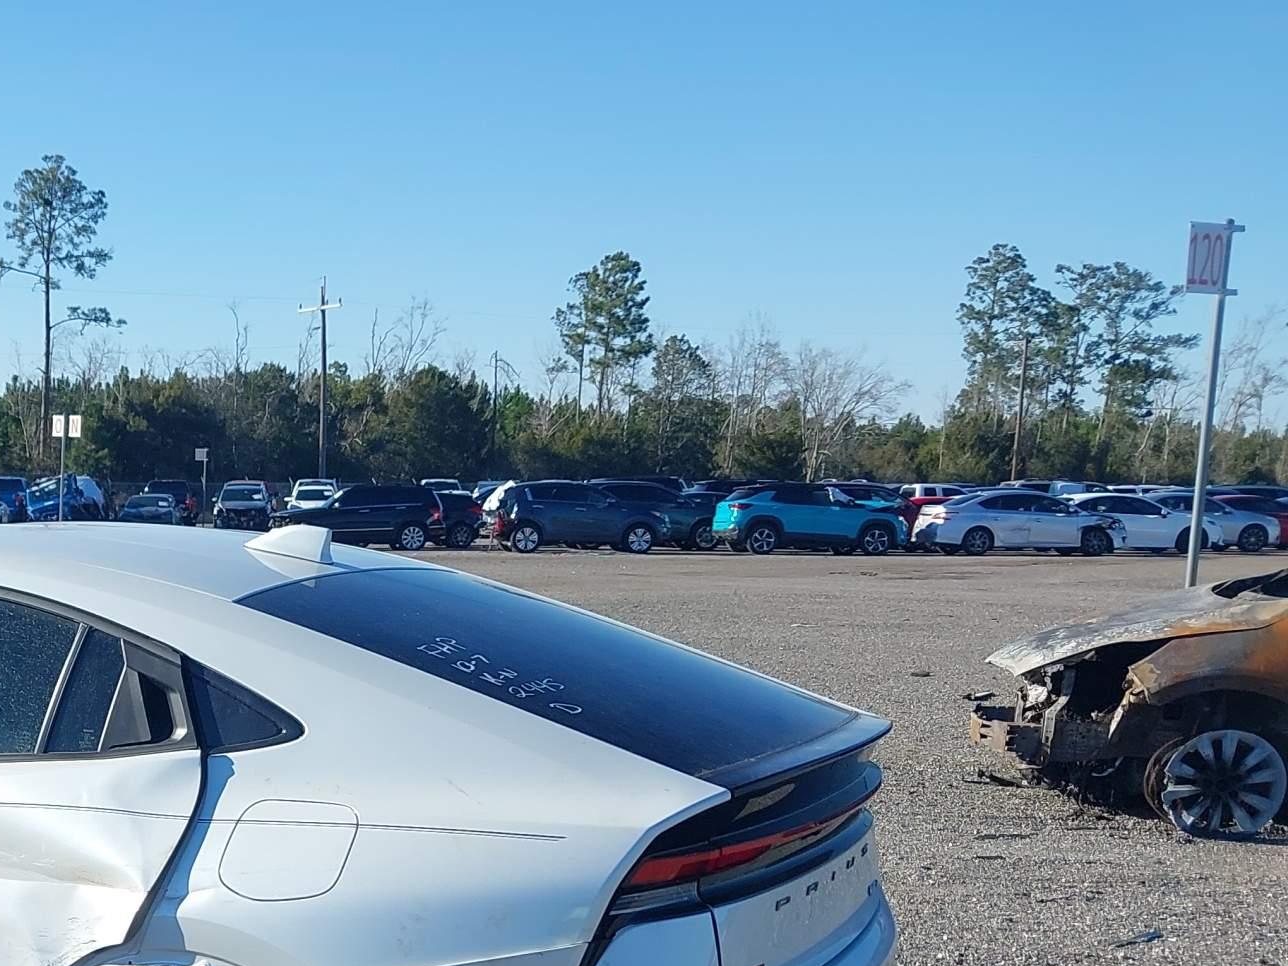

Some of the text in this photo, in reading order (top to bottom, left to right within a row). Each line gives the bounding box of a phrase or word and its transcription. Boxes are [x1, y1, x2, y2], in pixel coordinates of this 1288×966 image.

[1187, 232, 1225, 287] 120
[416, 637, 467, 659] FHP
[508, 678, 565, 698] 2445
[775, 843, 869, 911] PRIUS
